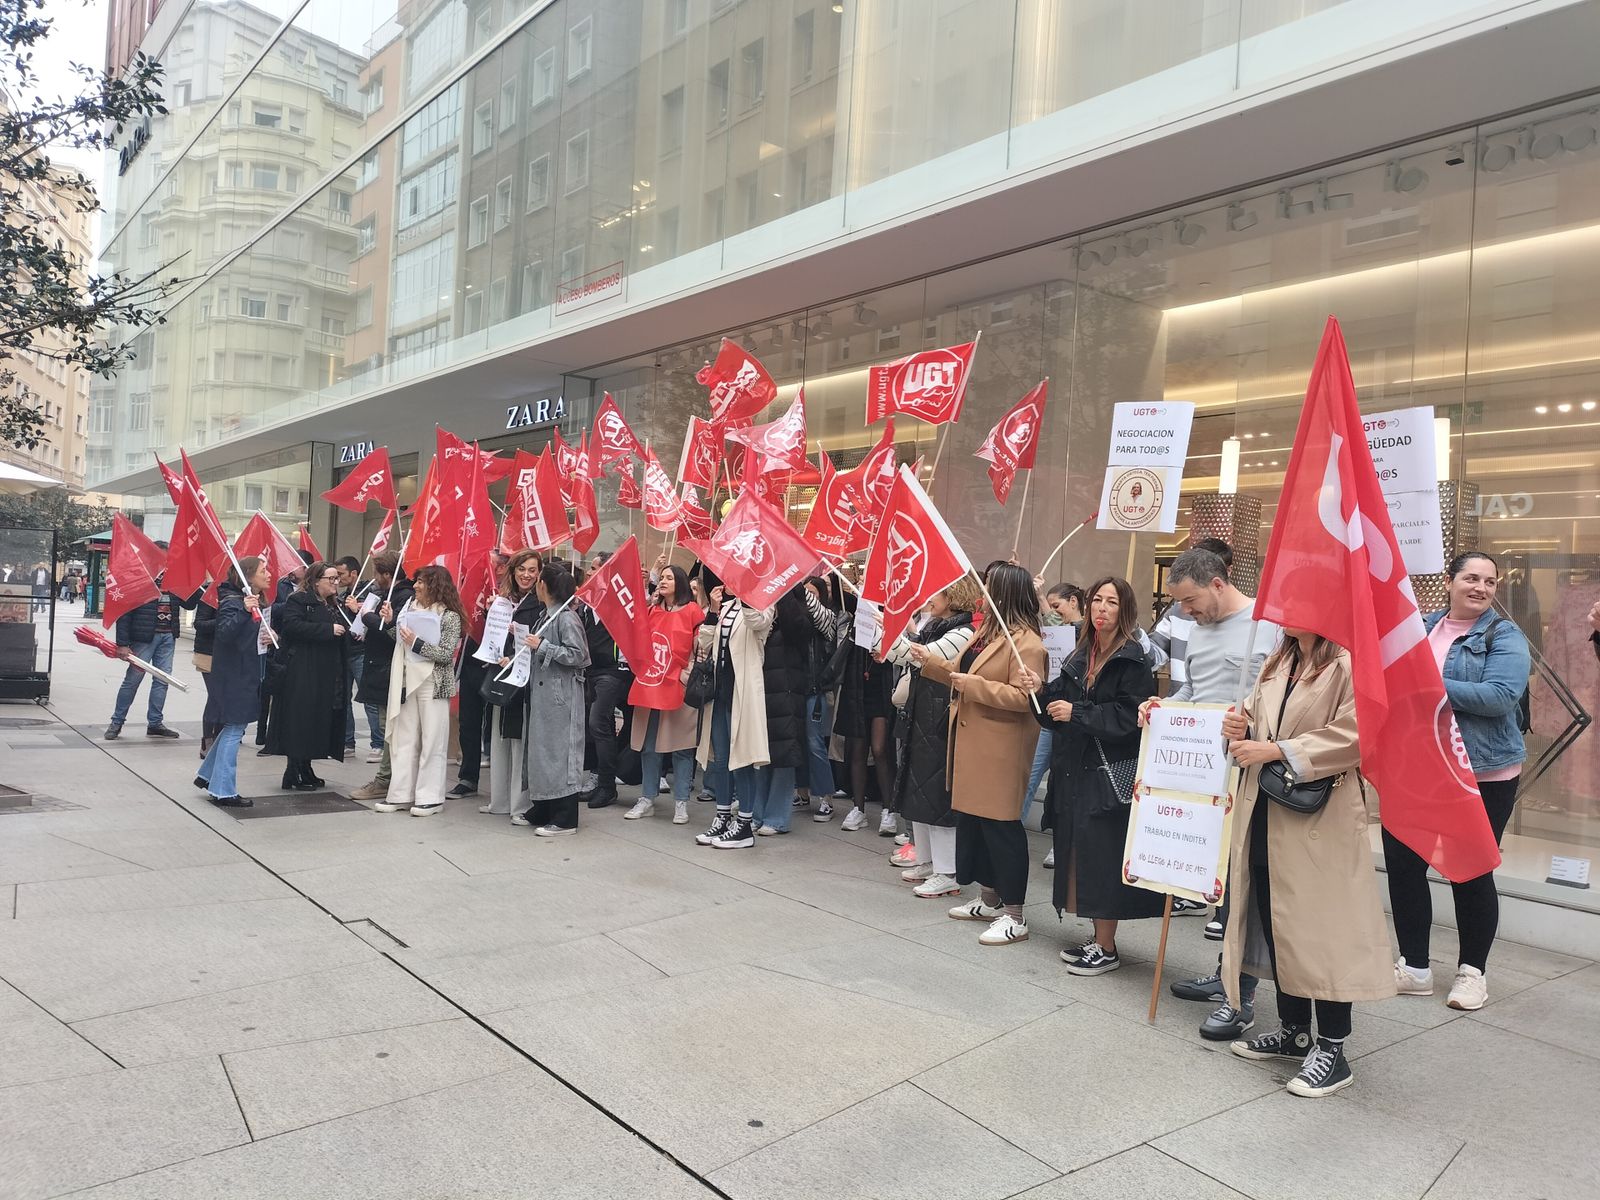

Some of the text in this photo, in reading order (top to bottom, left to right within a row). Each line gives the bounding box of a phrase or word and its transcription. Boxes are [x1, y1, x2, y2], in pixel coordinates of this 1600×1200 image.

[583, 272, 620, 297] BOMBEROS
[903, 361, 958, 393] UGT
[505, 396, 567, 430] ZARA
[1133, 408, 1151, 416] UGT
[1363, 421, 1377, 432] GT
[1116, 429, 1174, 438] NEGOCIACION
[1367, 435, 1412, 450] GÜEDAD
[340, 441, 375, 463] ZARA
[1115, 445, 1170, 455] PARA TOD@S
[1123, 505, 1138, 513] UGT
[1170, 716, 1188, 727] UGT
[1153, 748, 1217, 770] INDITEX
[1157, 805, 1176, 817] UGT
[1144, 826, 1208, 846] TRABAJO EN INDITEX
[1166, 859, 1172, 869] A
